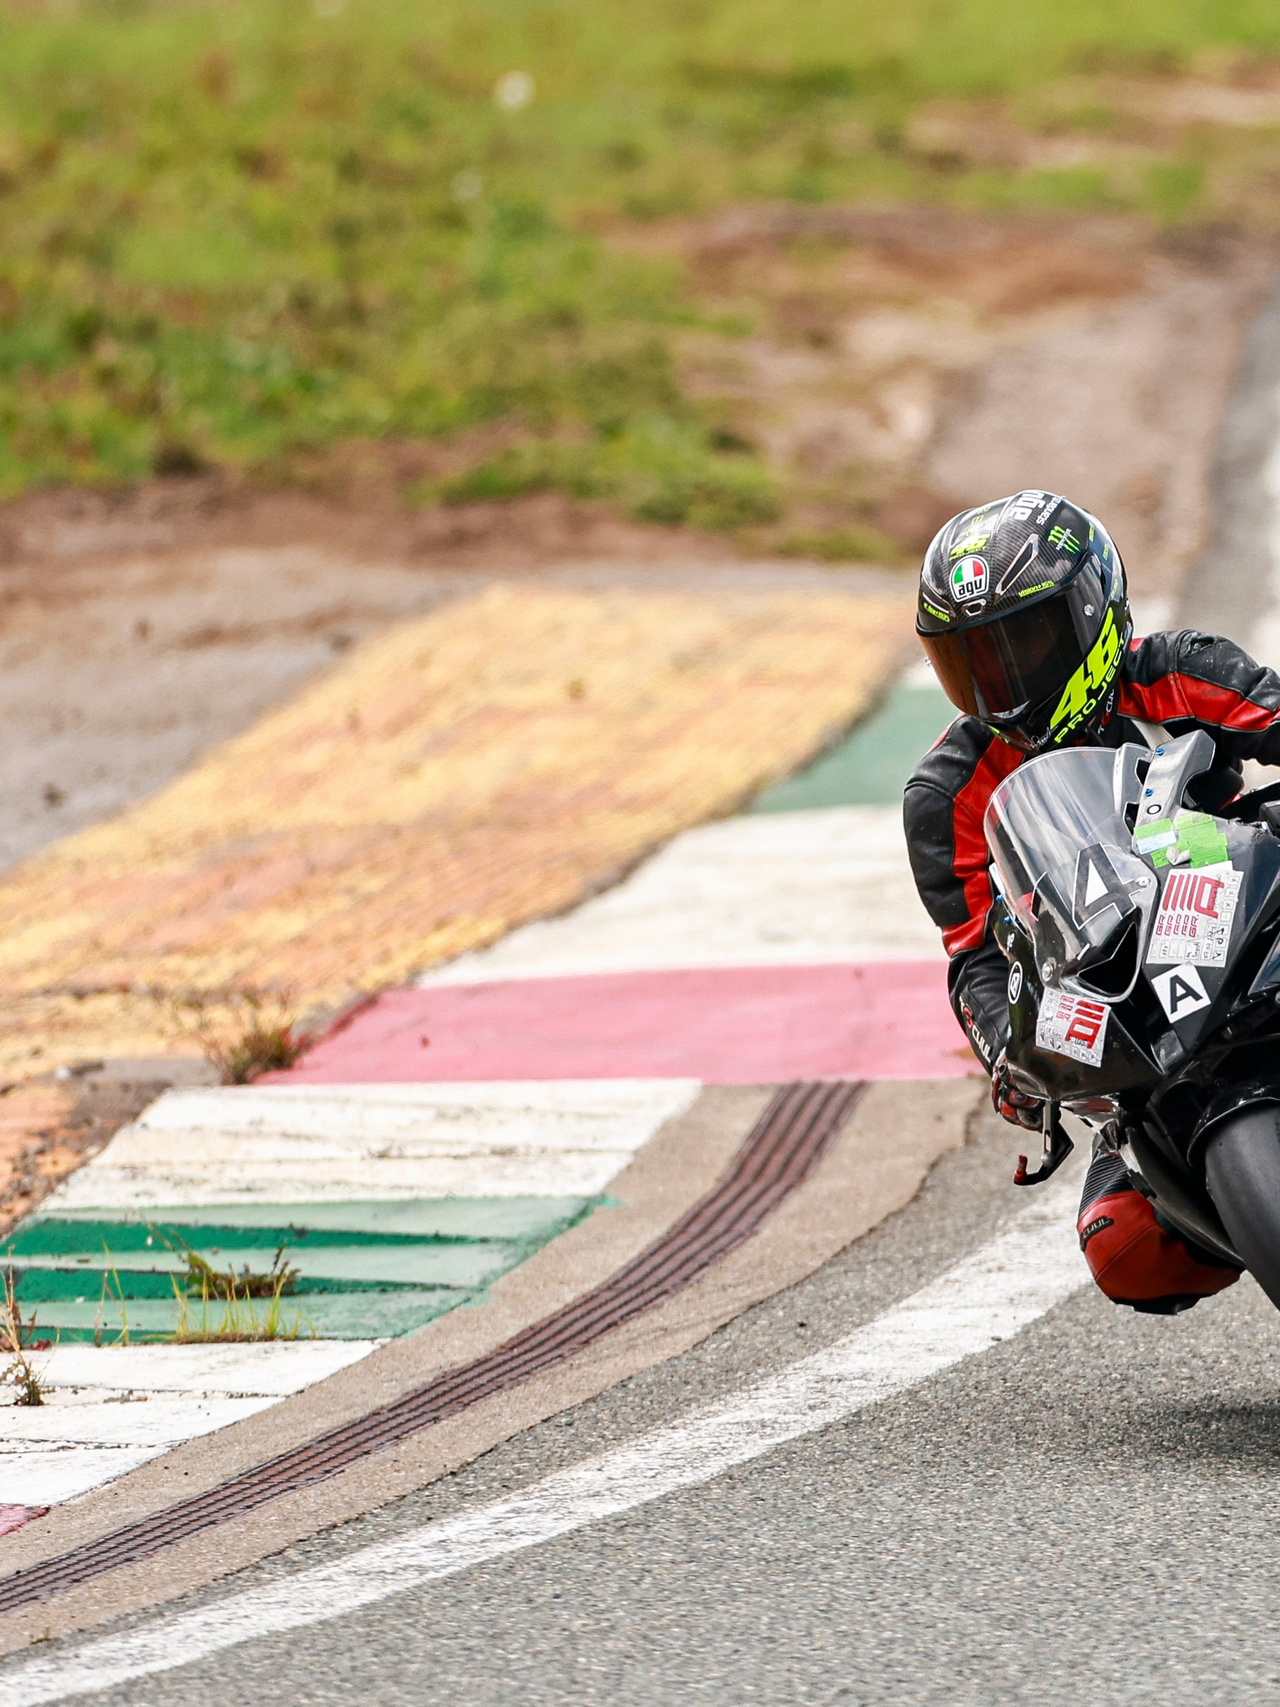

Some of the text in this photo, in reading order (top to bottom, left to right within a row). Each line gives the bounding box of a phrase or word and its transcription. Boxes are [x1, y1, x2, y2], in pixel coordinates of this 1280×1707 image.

[958, 578, 983, 597] agv
[1050, 607, 1118, 730] 46
[1054, 632, 1124, 743] PROJECT
[1169, 974, 1203, 1015] A
